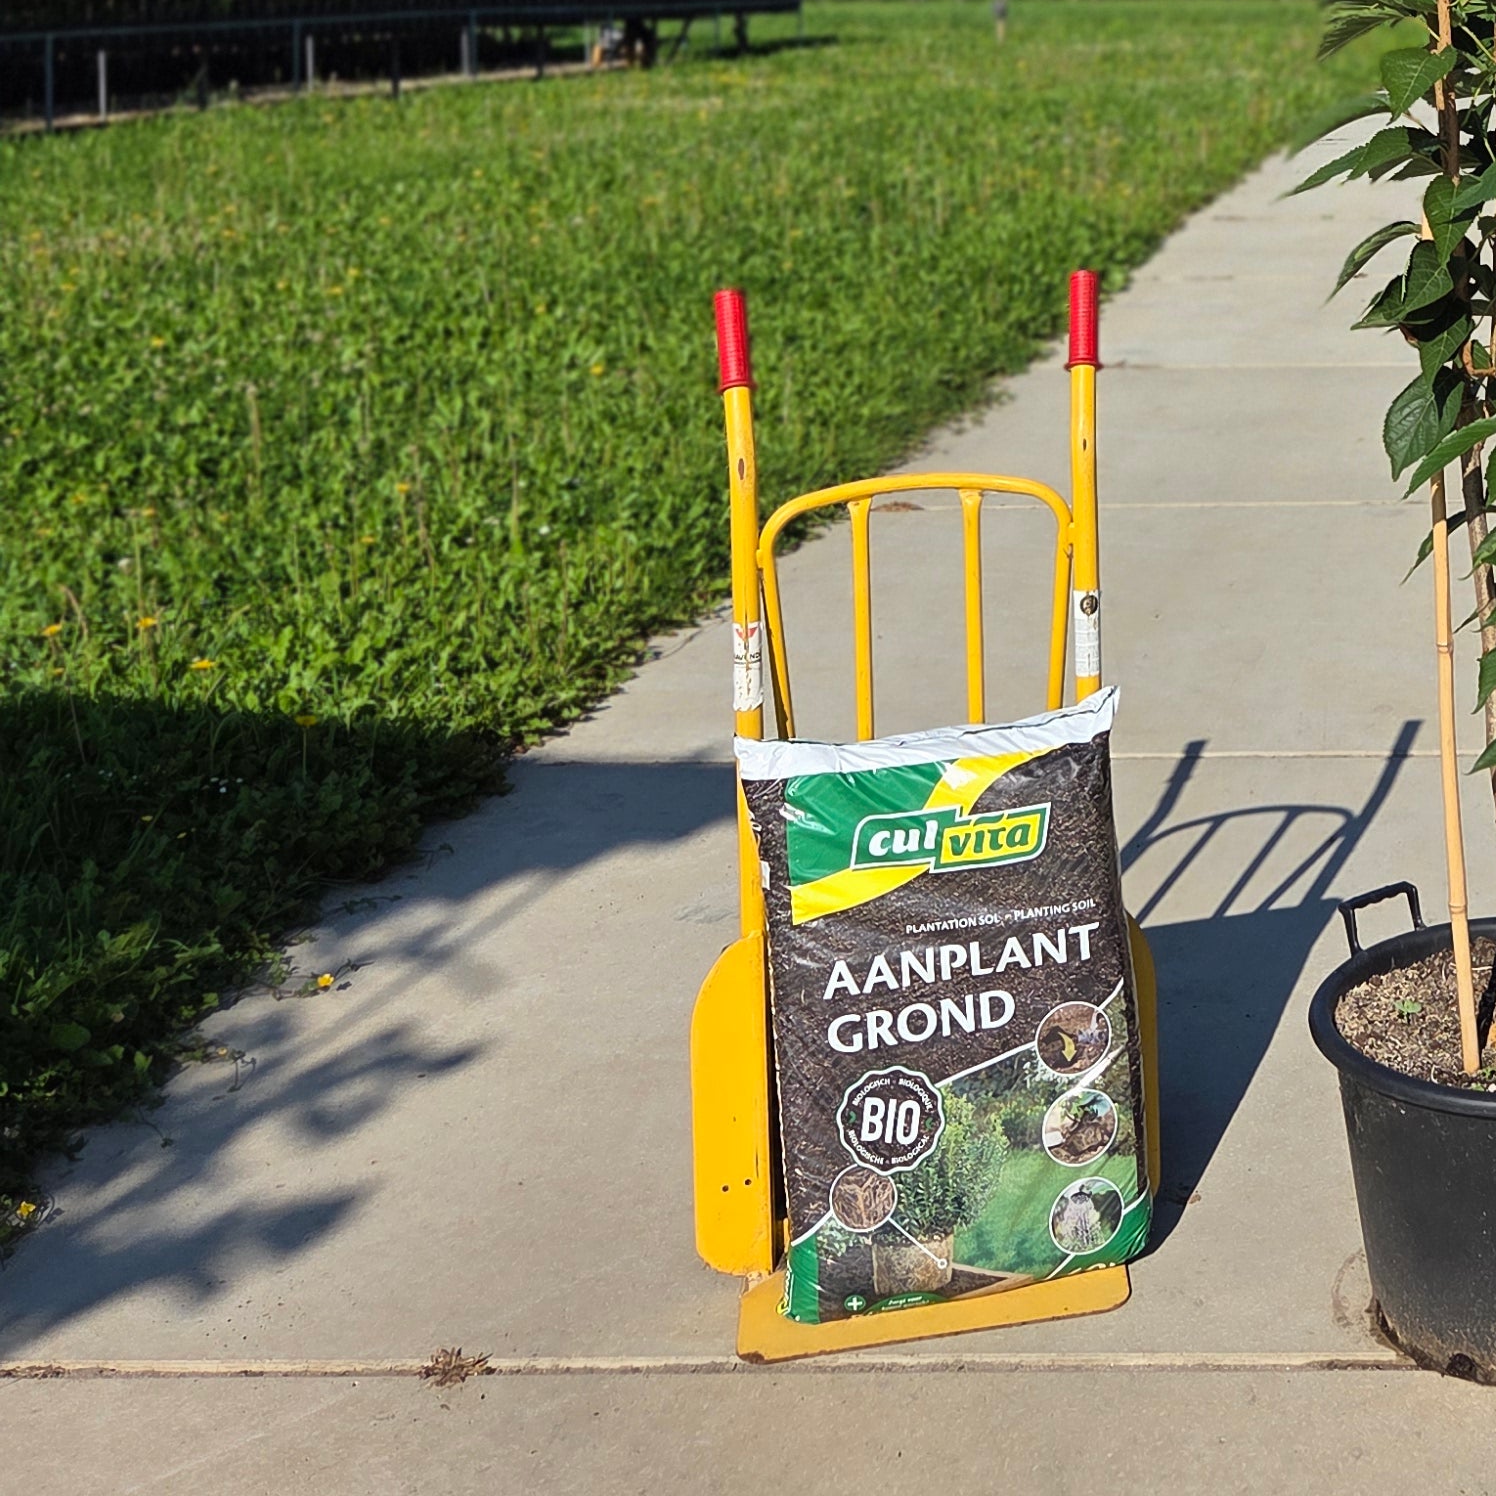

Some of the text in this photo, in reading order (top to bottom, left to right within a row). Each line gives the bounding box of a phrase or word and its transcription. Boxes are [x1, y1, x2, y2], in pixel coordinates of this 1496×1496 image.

[905, 898, 1097, 934] PLANTATION SOL PLANTING SOIL
[823, 922, 1099, 1000] AANPLANT
[827, 990, 1016, 1053] GROND
[860, 1096, 921, 1145] BIO
